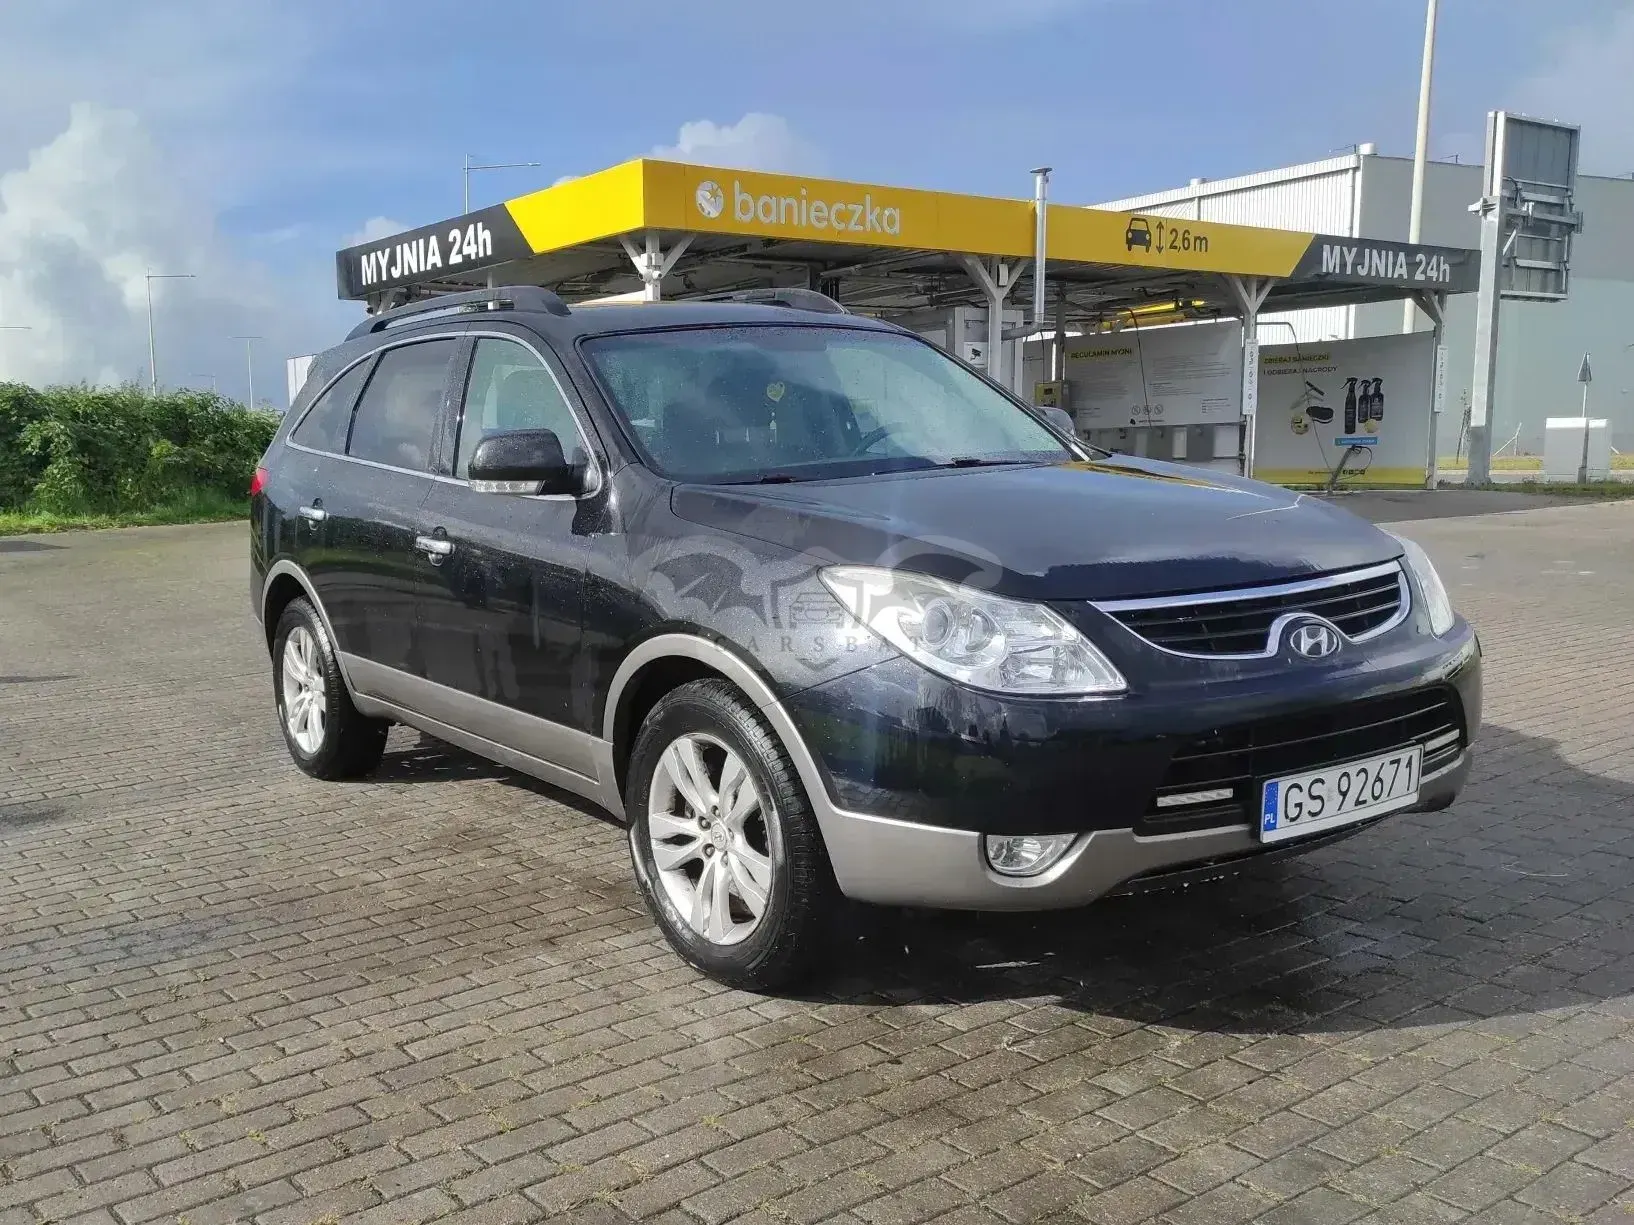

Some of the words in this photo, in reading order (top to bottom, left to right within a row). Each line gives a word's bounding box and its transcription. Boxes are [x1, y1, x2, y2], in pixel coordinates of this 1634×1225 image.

[734, 180, 901, 235] banieczka
[360, 237, 442, 286] MYJNIA
[448, 221, 493, 266] 24h
[1321, 244, 1408, 281] MYJNIA
[1414, 253, 1450, 283] 24h
[1302, 365, 1338, 374] NAGRODY
[1283, 777, 1326, 823] GS
[1337, 754, 1413, 812] 92671
[1264, 813, 1276, 824] PL
